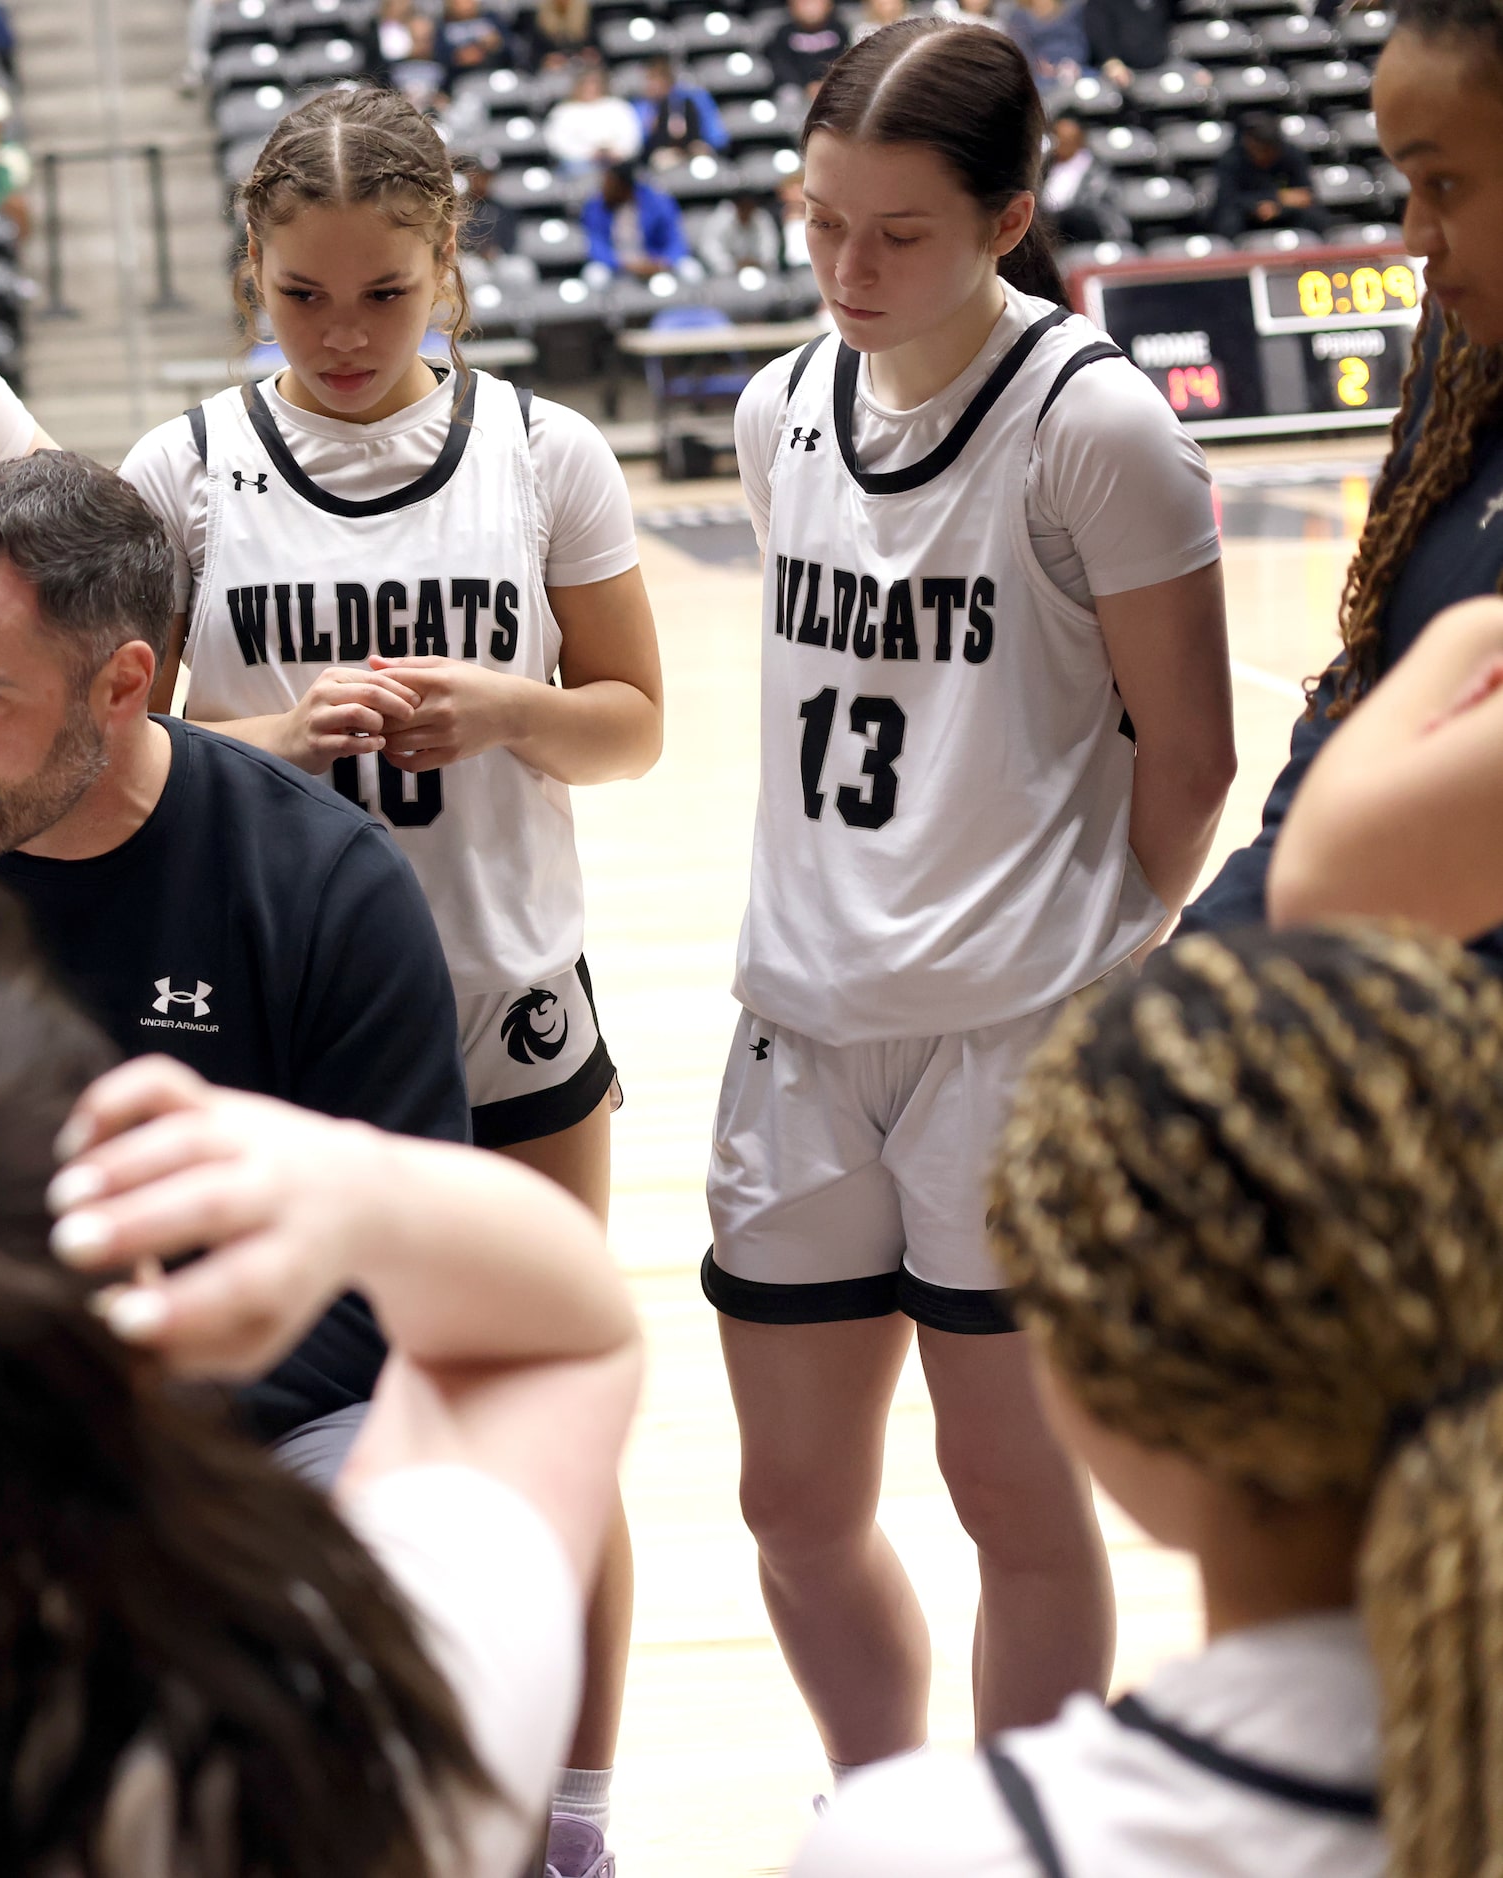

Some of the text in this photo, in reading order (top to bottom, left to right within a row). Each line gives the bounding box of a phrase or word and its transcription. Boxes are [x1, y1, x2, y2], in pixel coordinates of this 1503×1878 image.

[1298, 265, 1417, 318] 0:09
[1168, 365, 1220, 411] 14
[1337, 357, 1370, 406] 2
[226, 577, 520, 667] WILDCATS
[774, 554, 996, 666] WILDCATS
[798, 685, 909, 832] 13
[140, 1017, 219, 1033] UNDER ARMOUR
